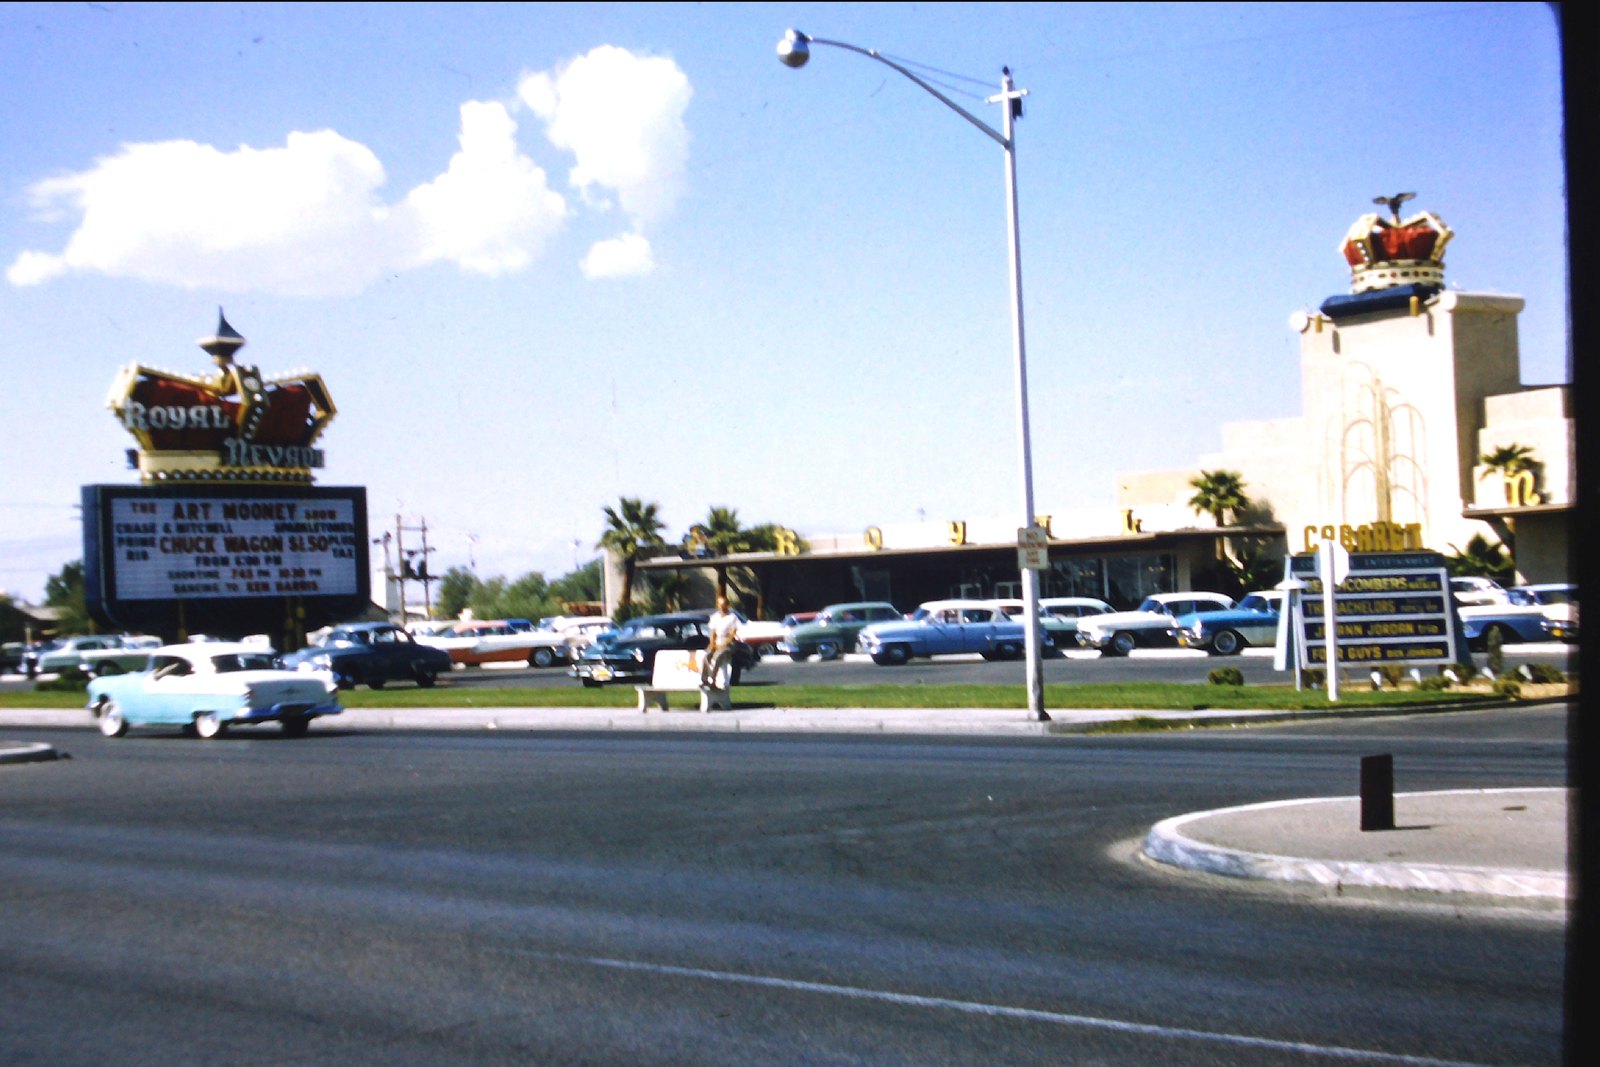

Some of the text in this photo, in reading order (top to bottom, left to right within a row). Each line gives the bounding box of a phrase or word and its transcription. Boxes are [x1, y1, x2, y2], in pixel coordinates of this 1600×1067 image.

[122, 398, 230, 431] ROYAL
[130, 502, 156, 514] THE
[173, 502, 211, 520] ART
[223, 502, 297, 520] MOONEY
[159, 535, 217, 554] CHUCK
[224, 535, 284, 552] WAGON
[1304, 522, 1421, 552] CABARET
[195, 555, 229, 566] FROM
[264, 555, 282, 566] PM
[1332, 600, 1396, 615] ACHELORS
[1312, 647, 1344, 661] FOR
[1347, 646, 1382, 659] GUYS
